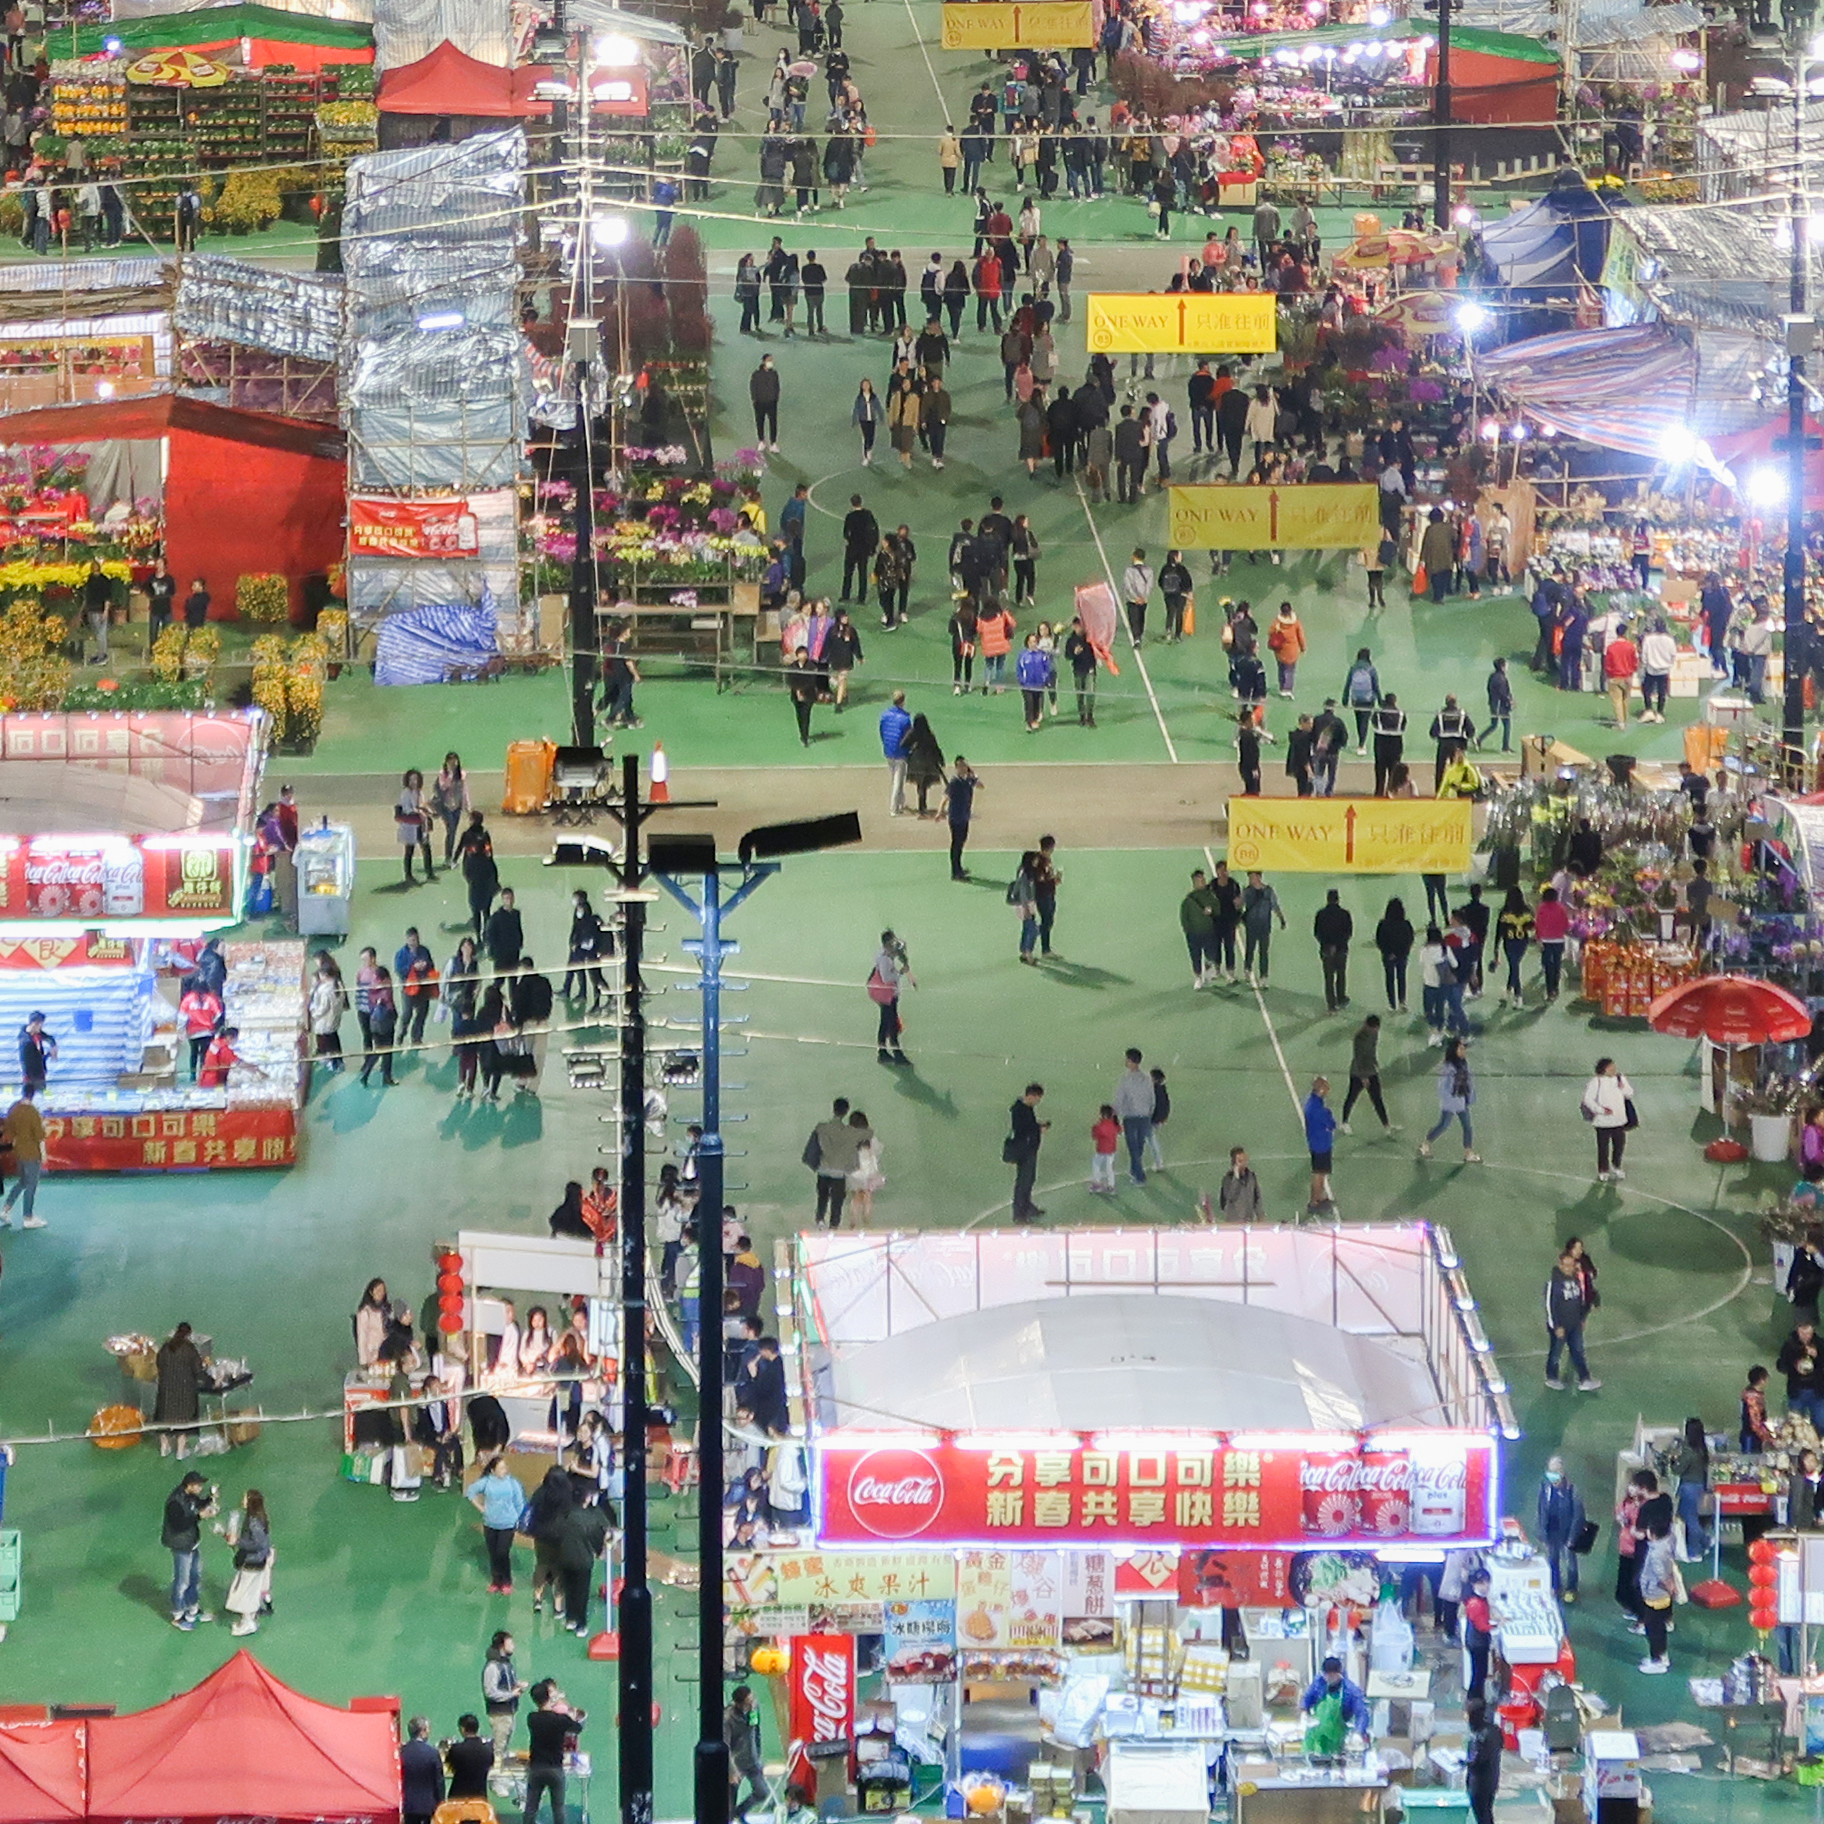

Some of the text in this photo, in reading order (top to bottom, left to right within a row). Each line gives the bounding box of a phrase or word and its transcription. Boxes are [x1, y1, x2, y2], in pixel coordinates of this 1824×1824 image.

[947, 18, 1005, 29] ONE WAY
[1094, 316, 1169, 328] ONE WAY
[1176, 509, 1259, 522] ONE WAY
[1236, 824, 1332, 841] ONE WAY
[143, 1138, 295, 1163] 新春共享快
[988, 1451, 1261, 1488] 分享可口可樂
[853, 1476, 933, 1505] Coca-Cola
[988, 1491, 1261, 1527] 新春共享快樂
[814, 1570, 930, 1599] 冰爽果汁
